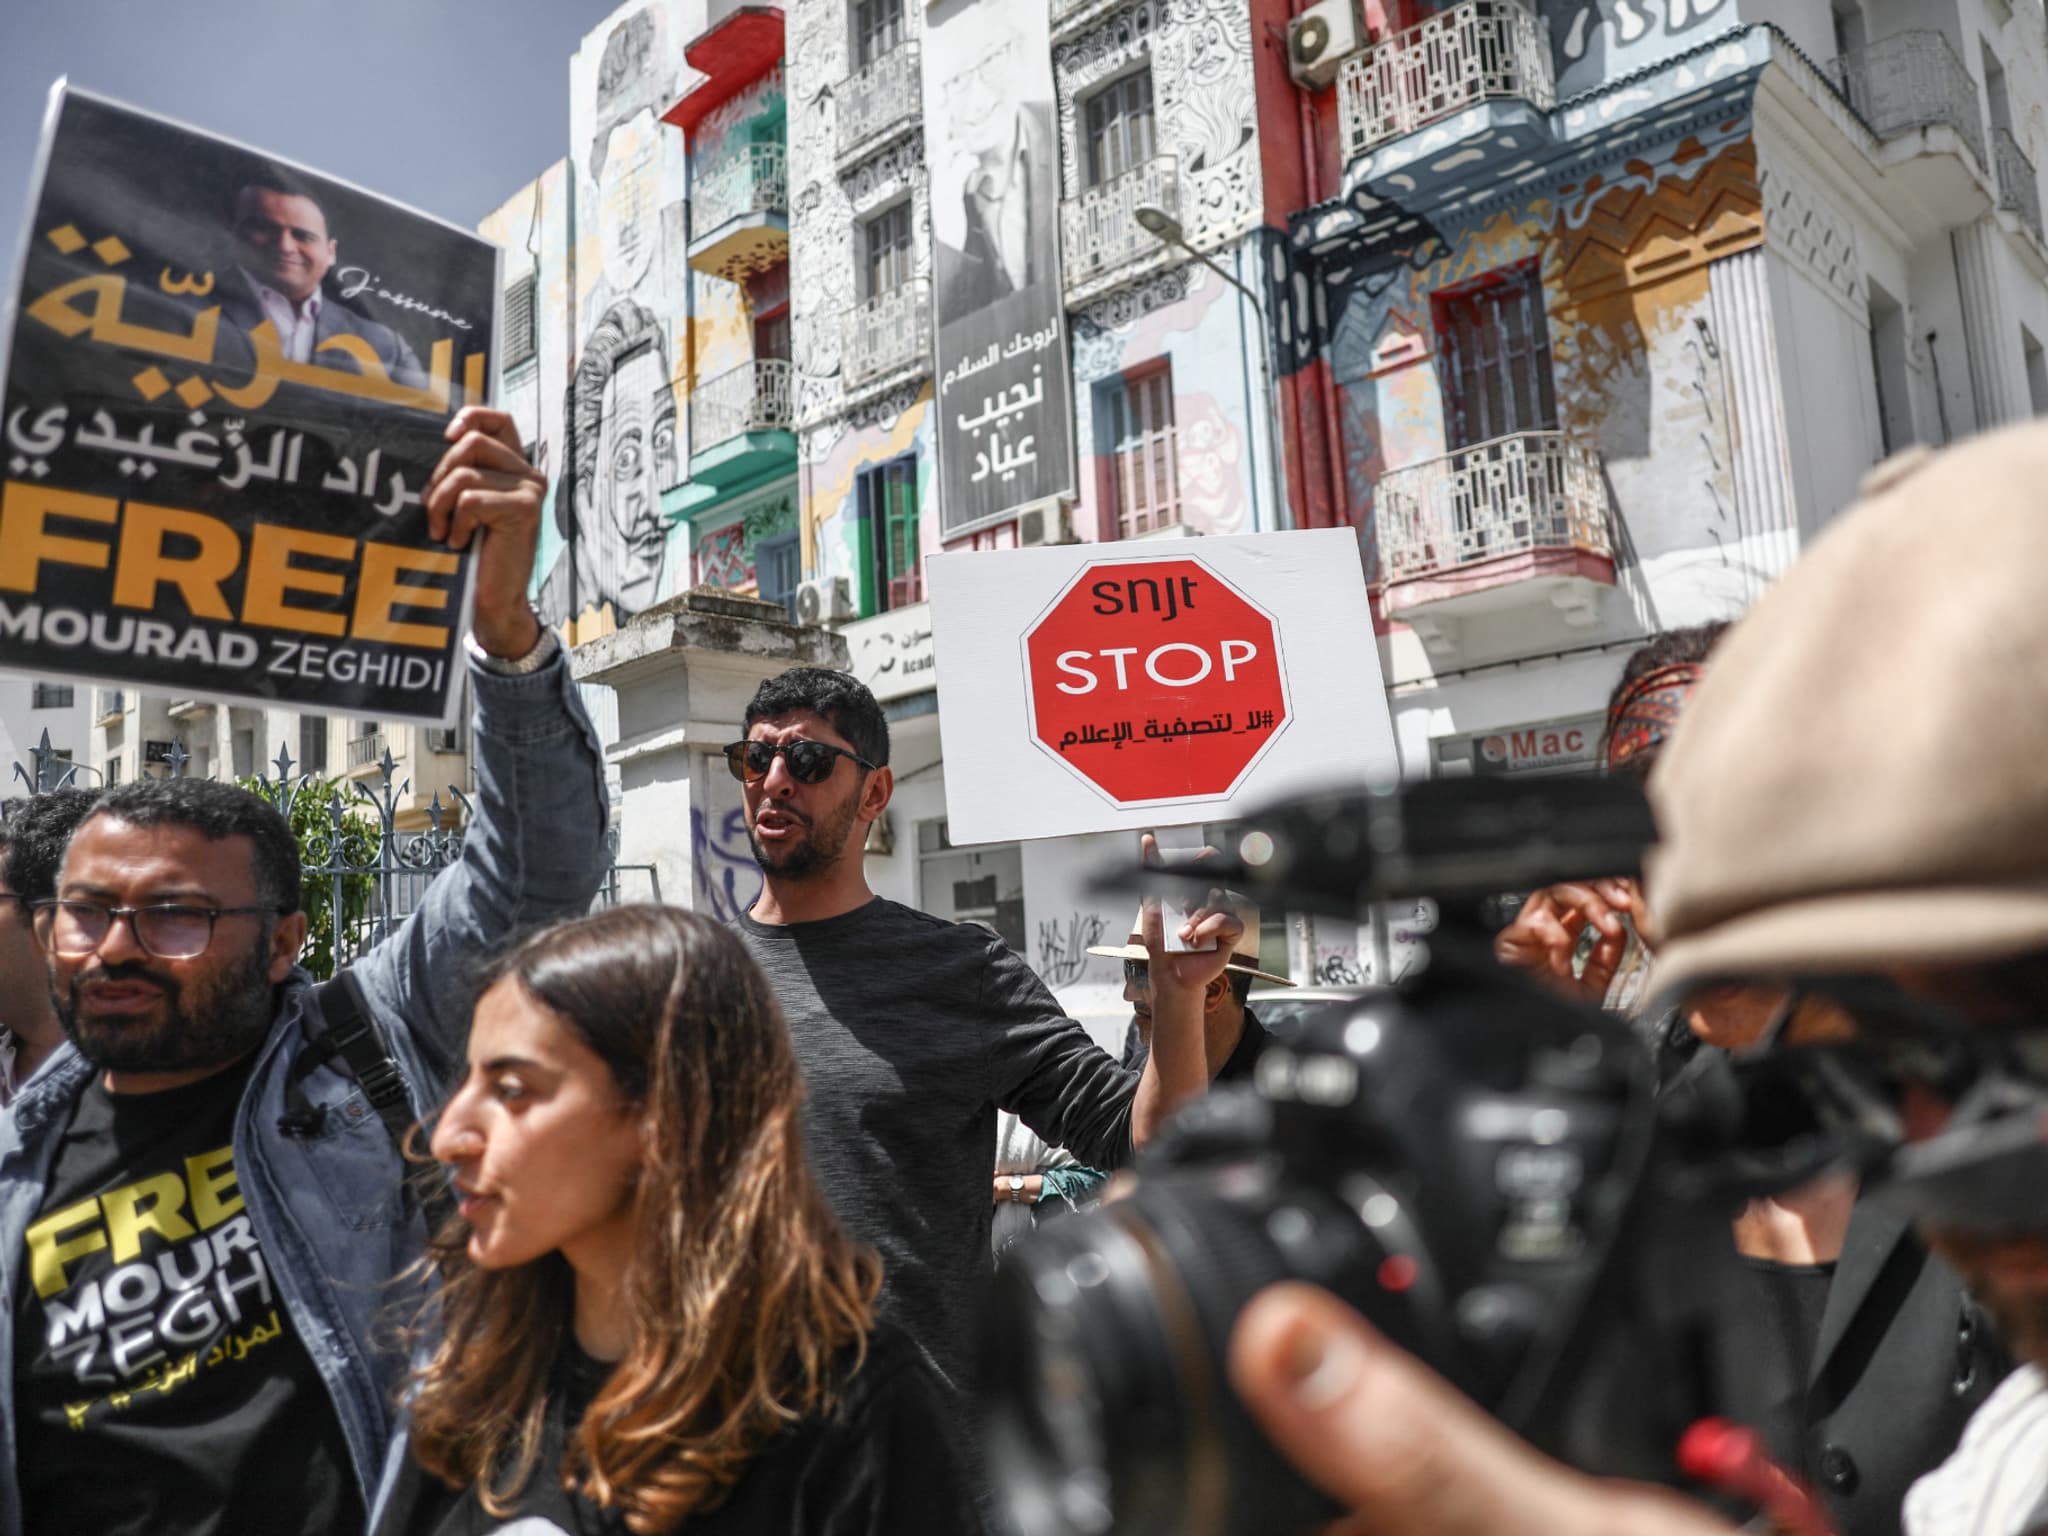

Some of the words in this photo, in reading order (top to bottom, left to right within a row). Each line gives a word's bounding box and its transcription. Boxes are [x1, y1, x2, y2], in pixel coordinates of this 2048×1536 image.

[336, 266, 473, 329] J'assume
[941, 343, 999, 396] السلام
[1003, 317, 1058, 358] لروحك
[957, 364, 1043, 437] نجيب
[322, 448, 422, 516] راد
[971, 433, 1037, 482] عياد
[0, 480, 460, 649] FREE
[0, 599, 259, 668] MOURAD
[268, 640, 444, 692] ZEGHIDI
[903, 654, 935, 675] Acad
[1055, 639, 1258, 695] STOP
[1511, 729, 1585, 759] Mac
[25, 1145, 246, 1299] FRE
[44, 1215, 260, 1348] MOUR
[50, 1251, 272, 1383] ZEGH
